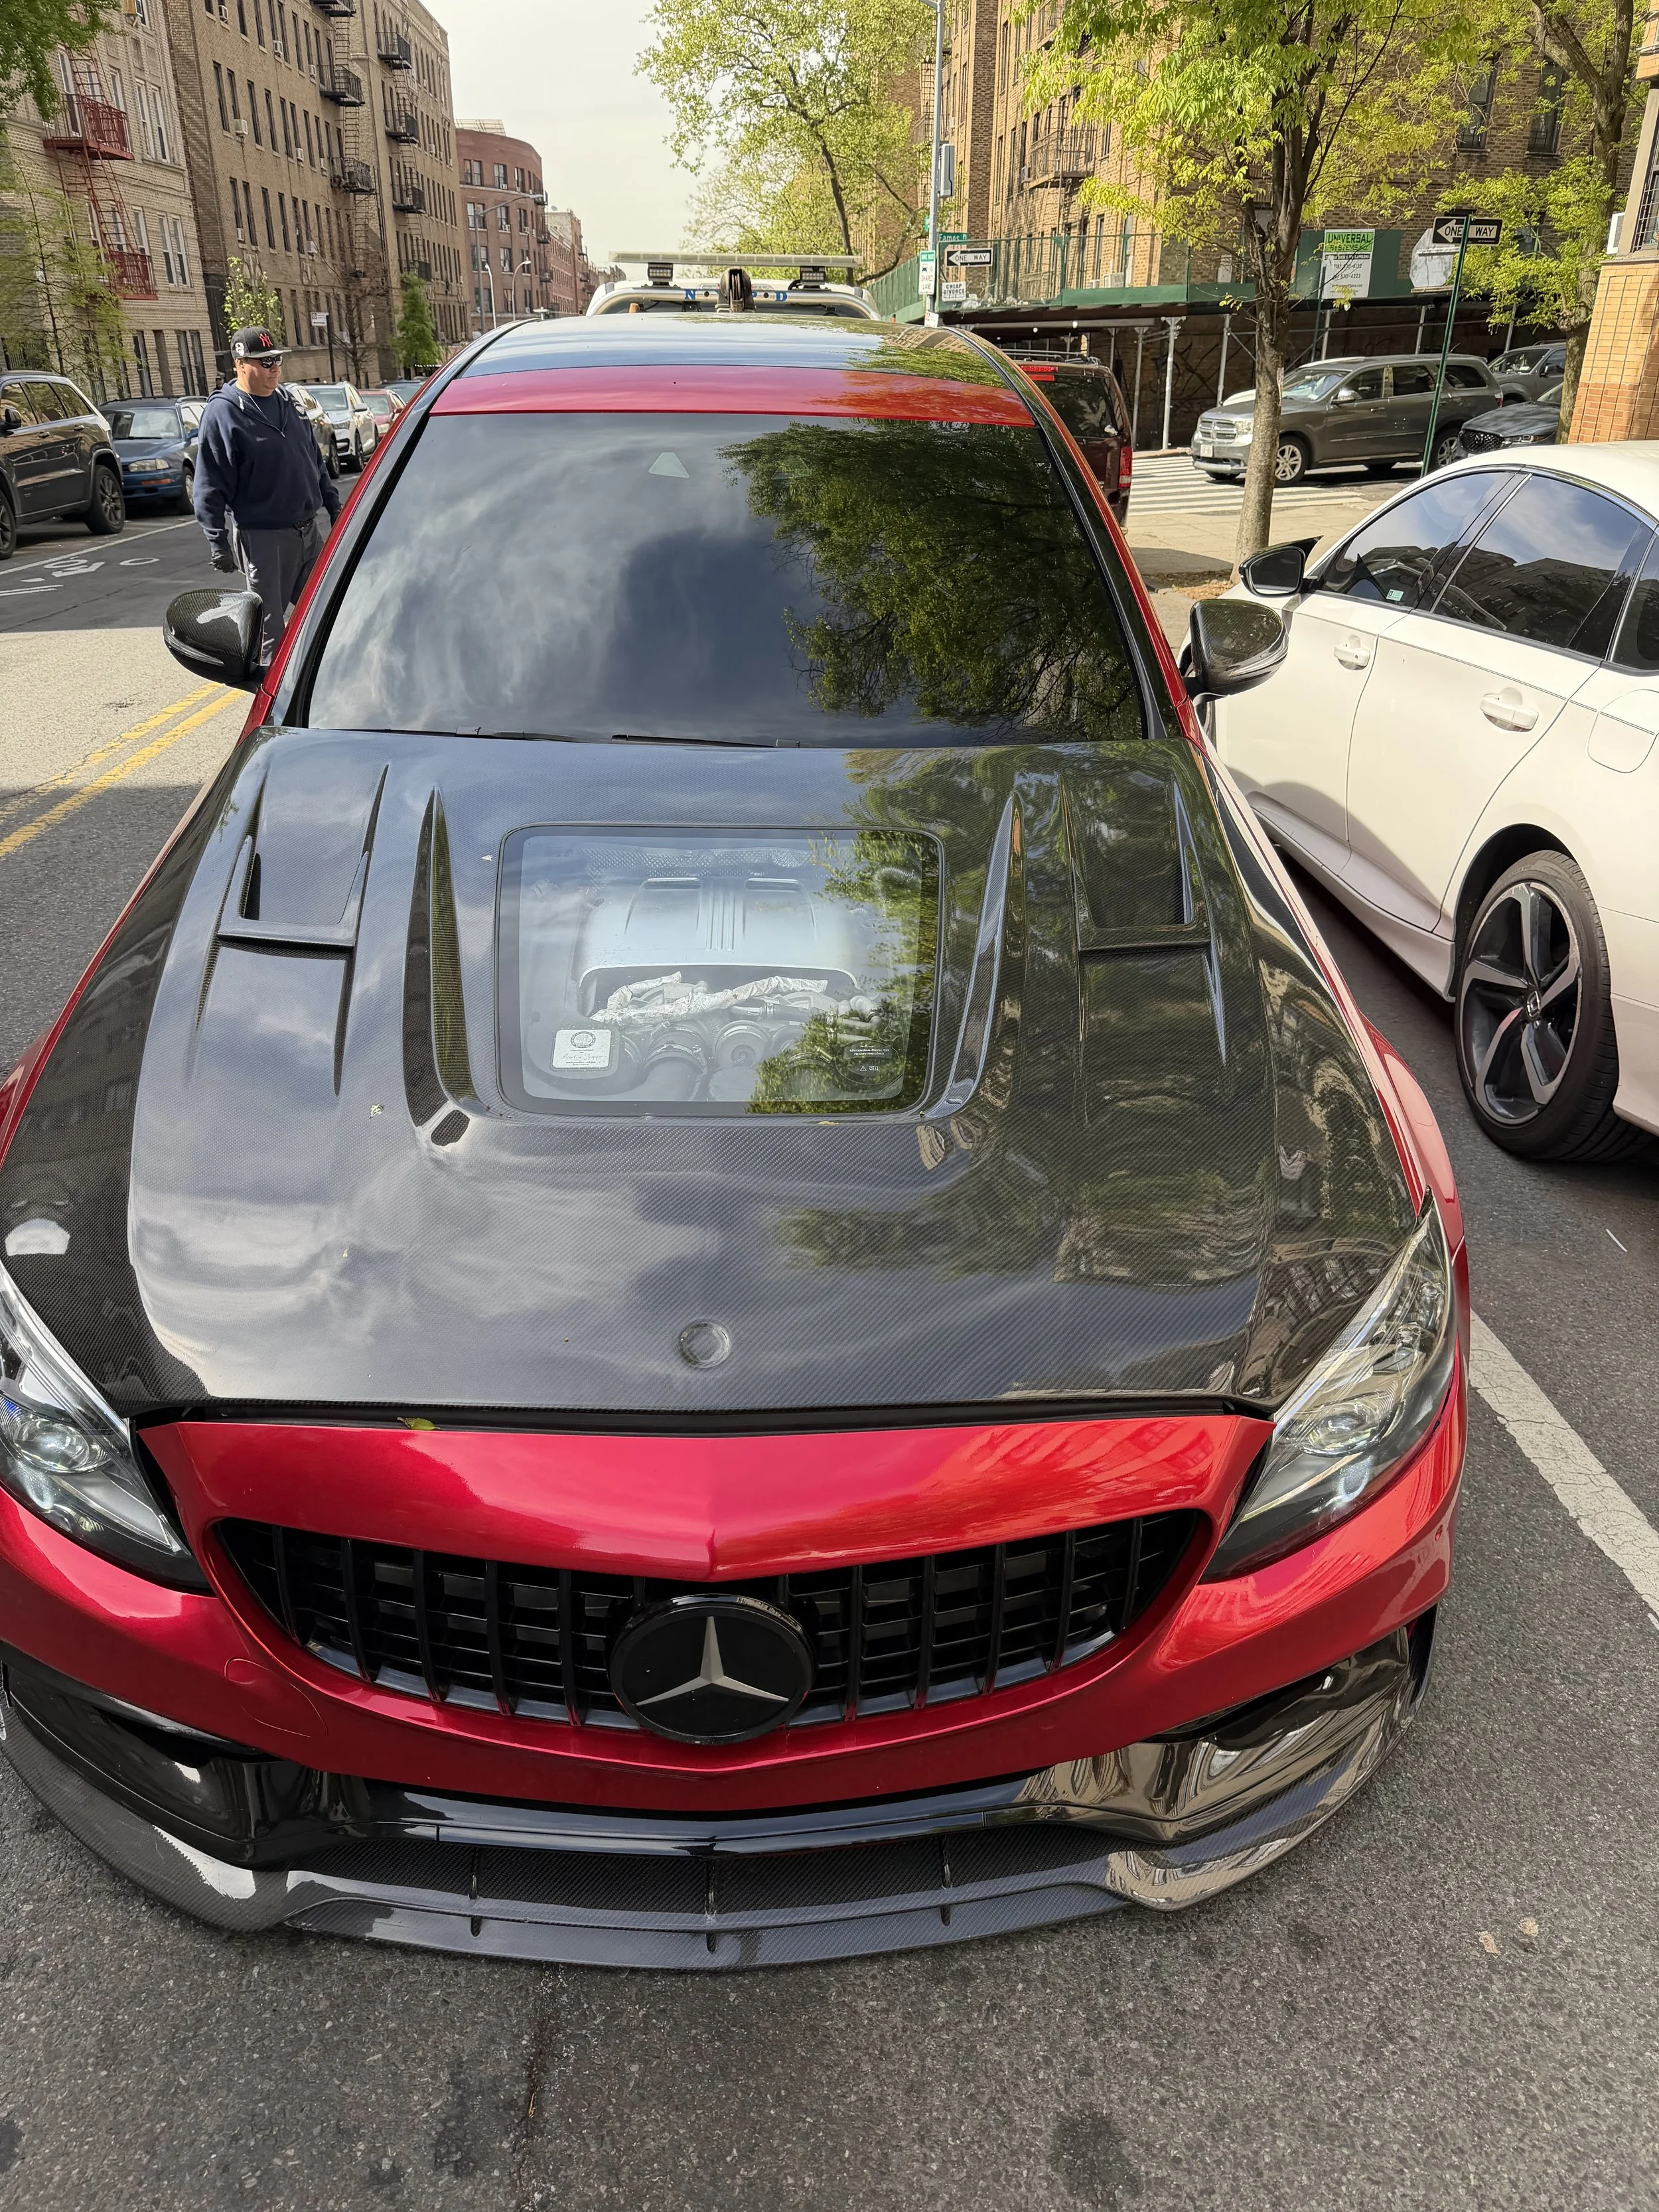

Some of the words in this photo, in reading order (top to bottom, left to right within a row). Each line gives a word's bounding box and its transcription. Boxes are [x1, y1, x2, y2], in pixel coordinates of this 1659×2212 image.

[1445, 226, 1463, 236] ONE
[1475, 226, 1494, 237] WAY
[1328, 233, 1371, 244] UNIVERSAL
